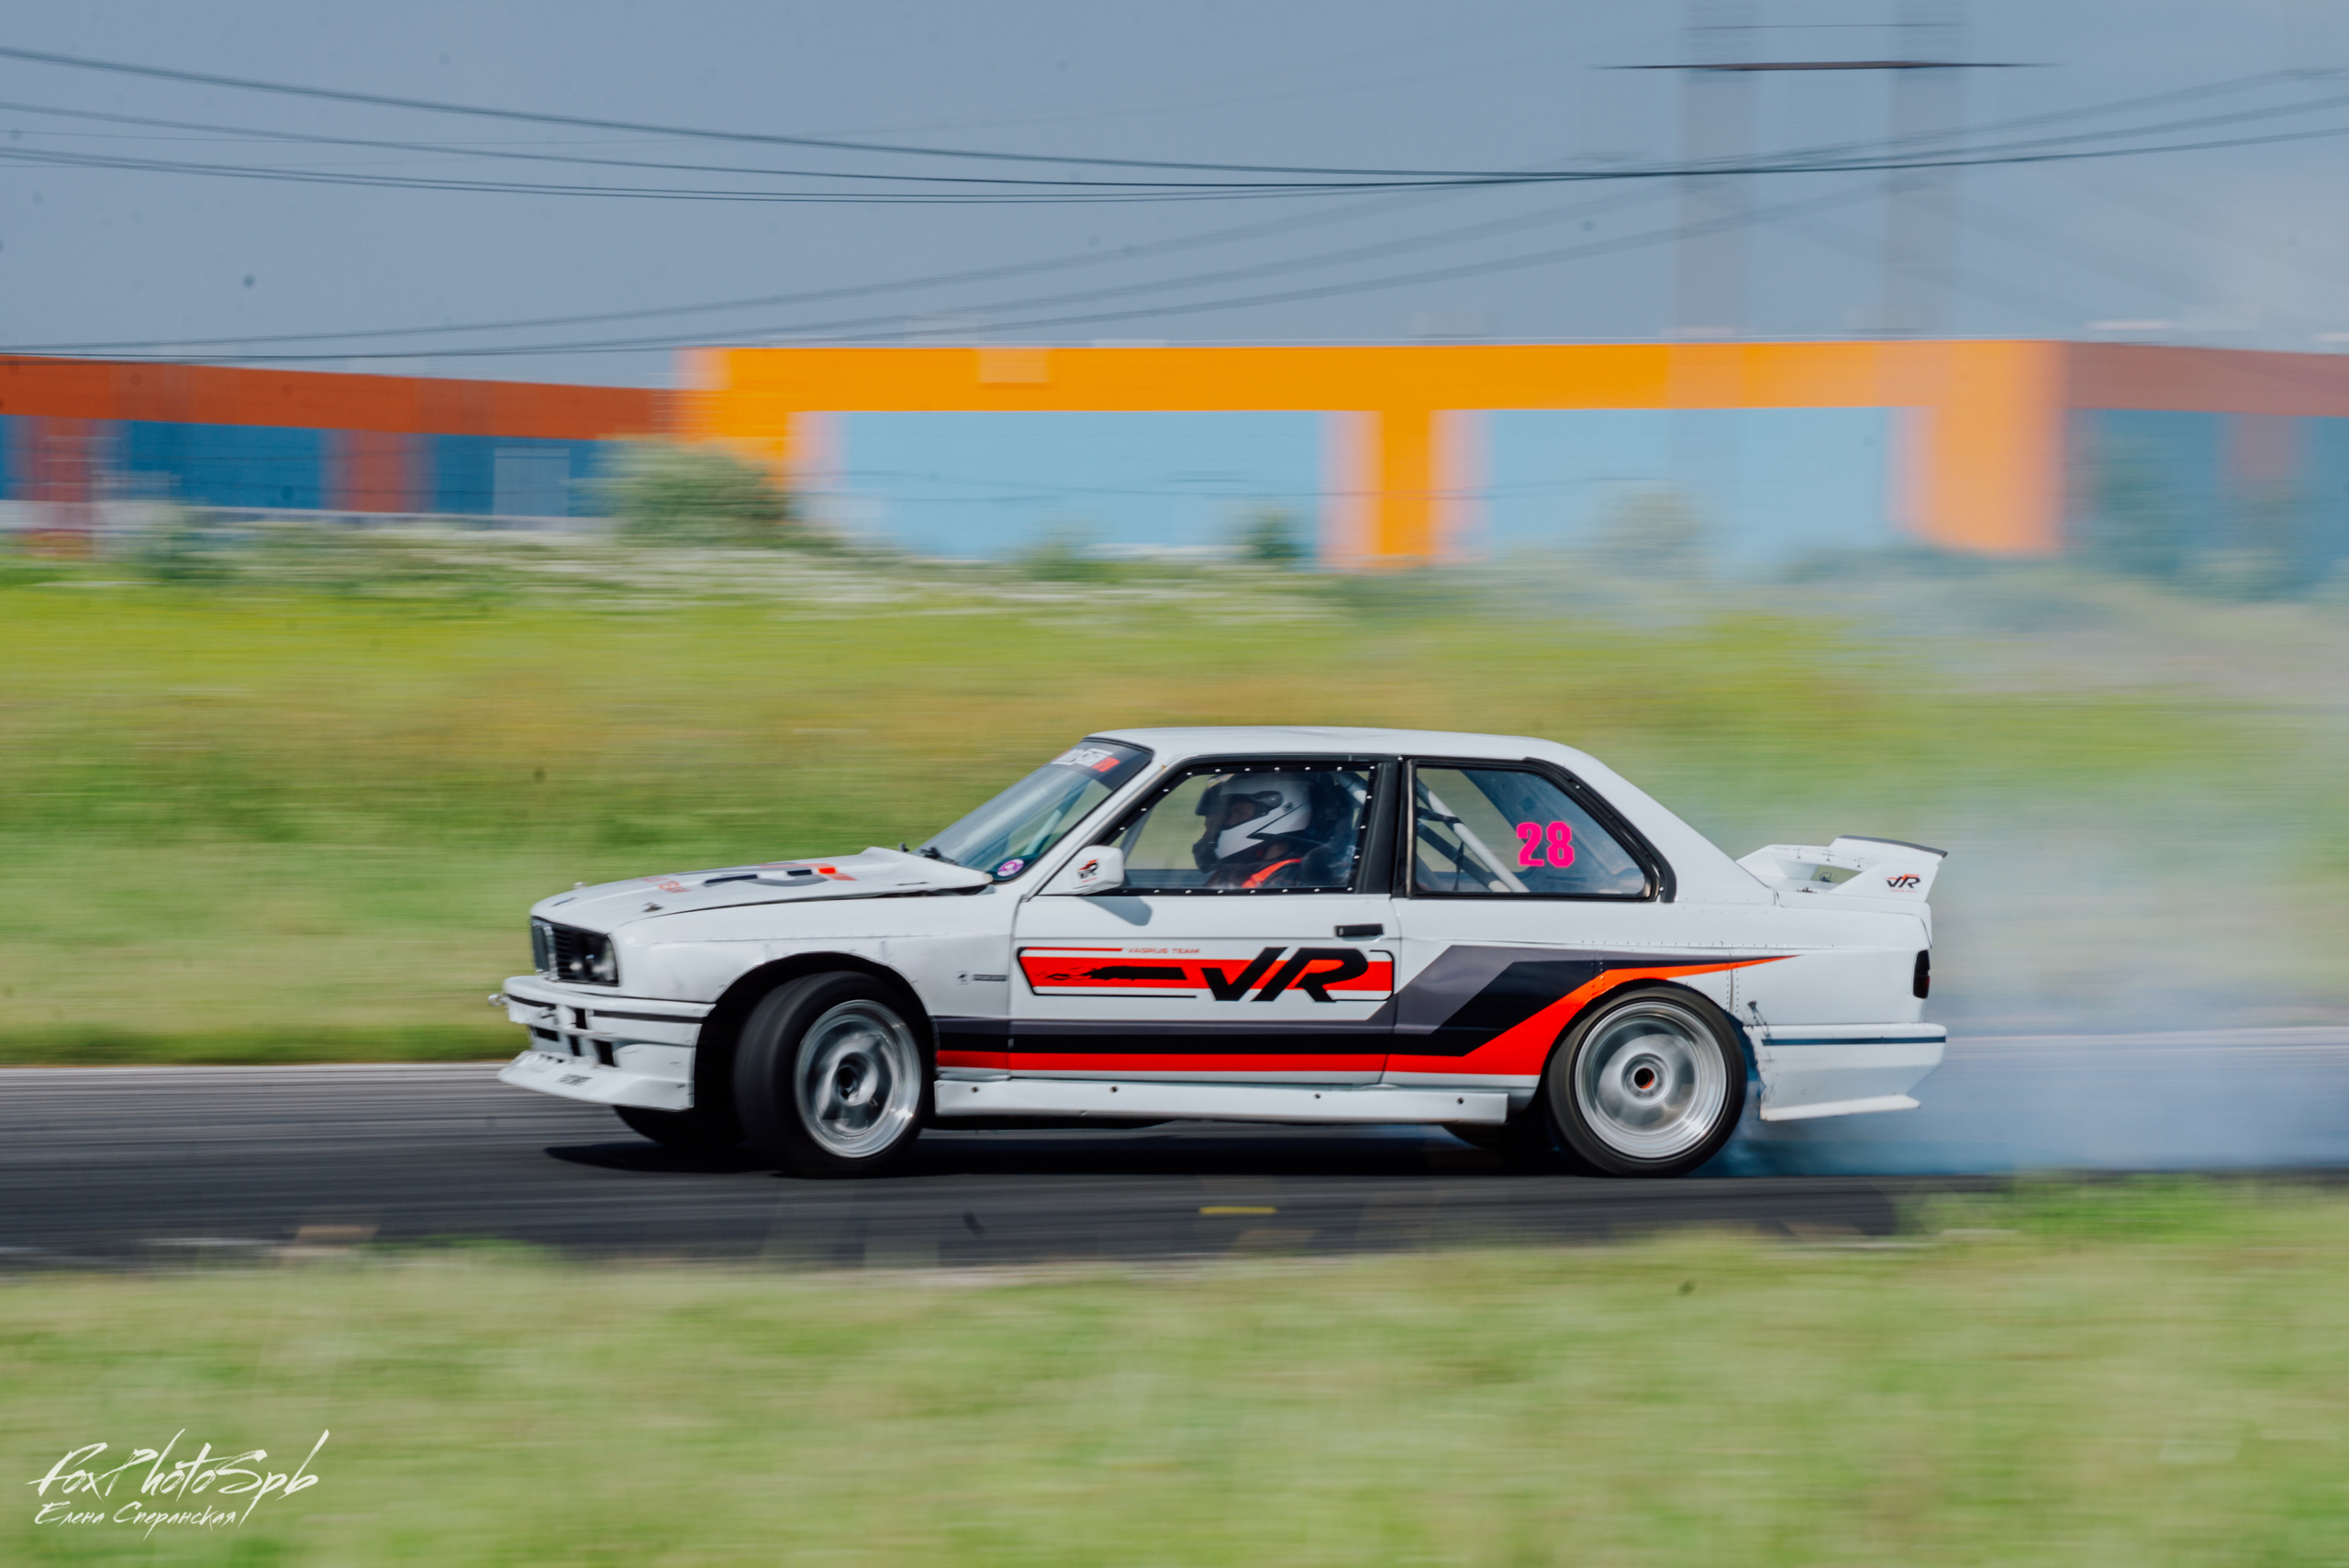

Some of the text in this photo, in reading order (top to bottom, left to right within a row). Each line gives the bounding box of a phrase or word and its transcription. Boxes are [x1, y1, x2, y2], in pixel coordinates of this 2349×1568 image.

[1516, 820, 1575, 868] 28
[1886, 875, 1921, 889] VR
[1200, 947, 1369, 1003] VR
